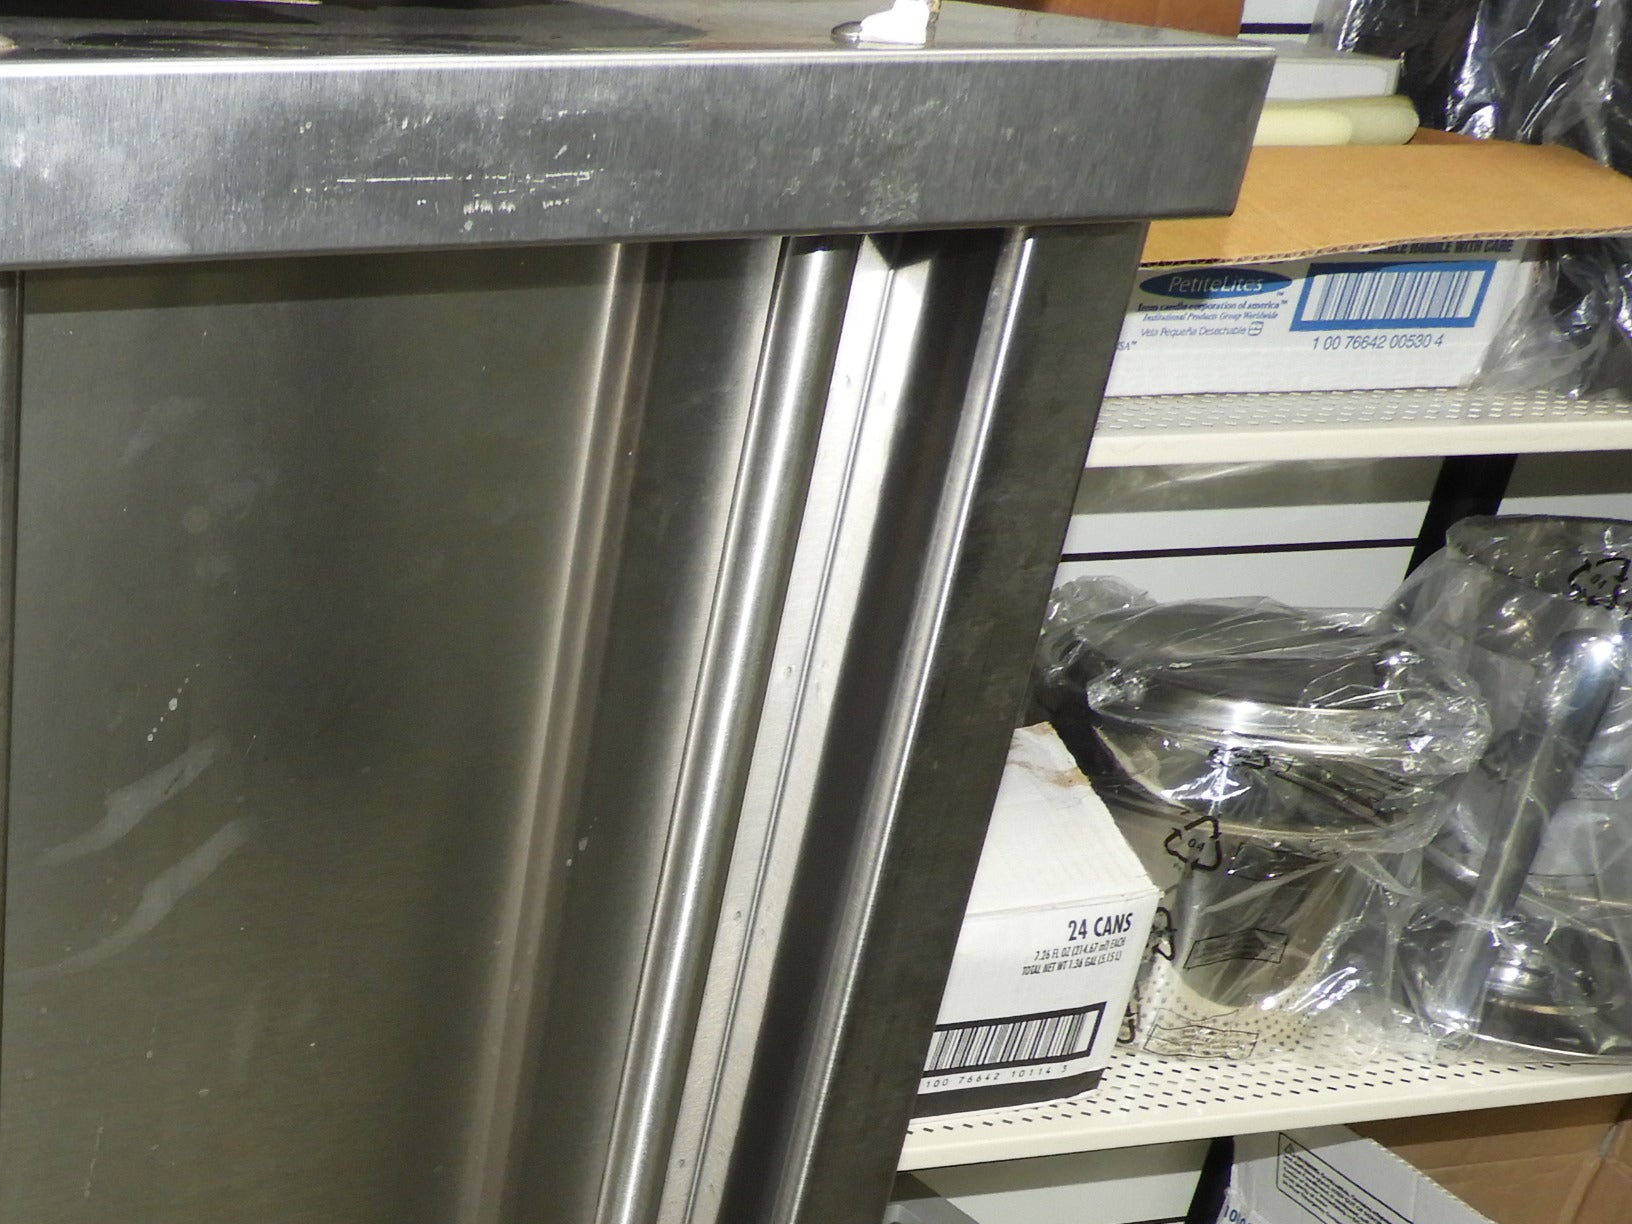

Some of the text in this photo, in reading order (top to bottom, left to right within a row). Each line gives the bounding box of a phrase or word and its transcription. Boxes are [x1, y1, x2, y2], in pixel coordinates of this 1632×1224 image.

[1168, 274, 1264, 293] PetiteLites
[1324, 335, 1341, 350] 00
[1345, 334, 1387, 349] 76642
[1389, 333, 1431, 348] 00530
[1434, 333, 1445, 347] 4
[1068, 912, 1133, 941] 24 CANS
[959, 1072, 1001, 1084] 76642
[1011, 1067, 1052, 1078] 10114
